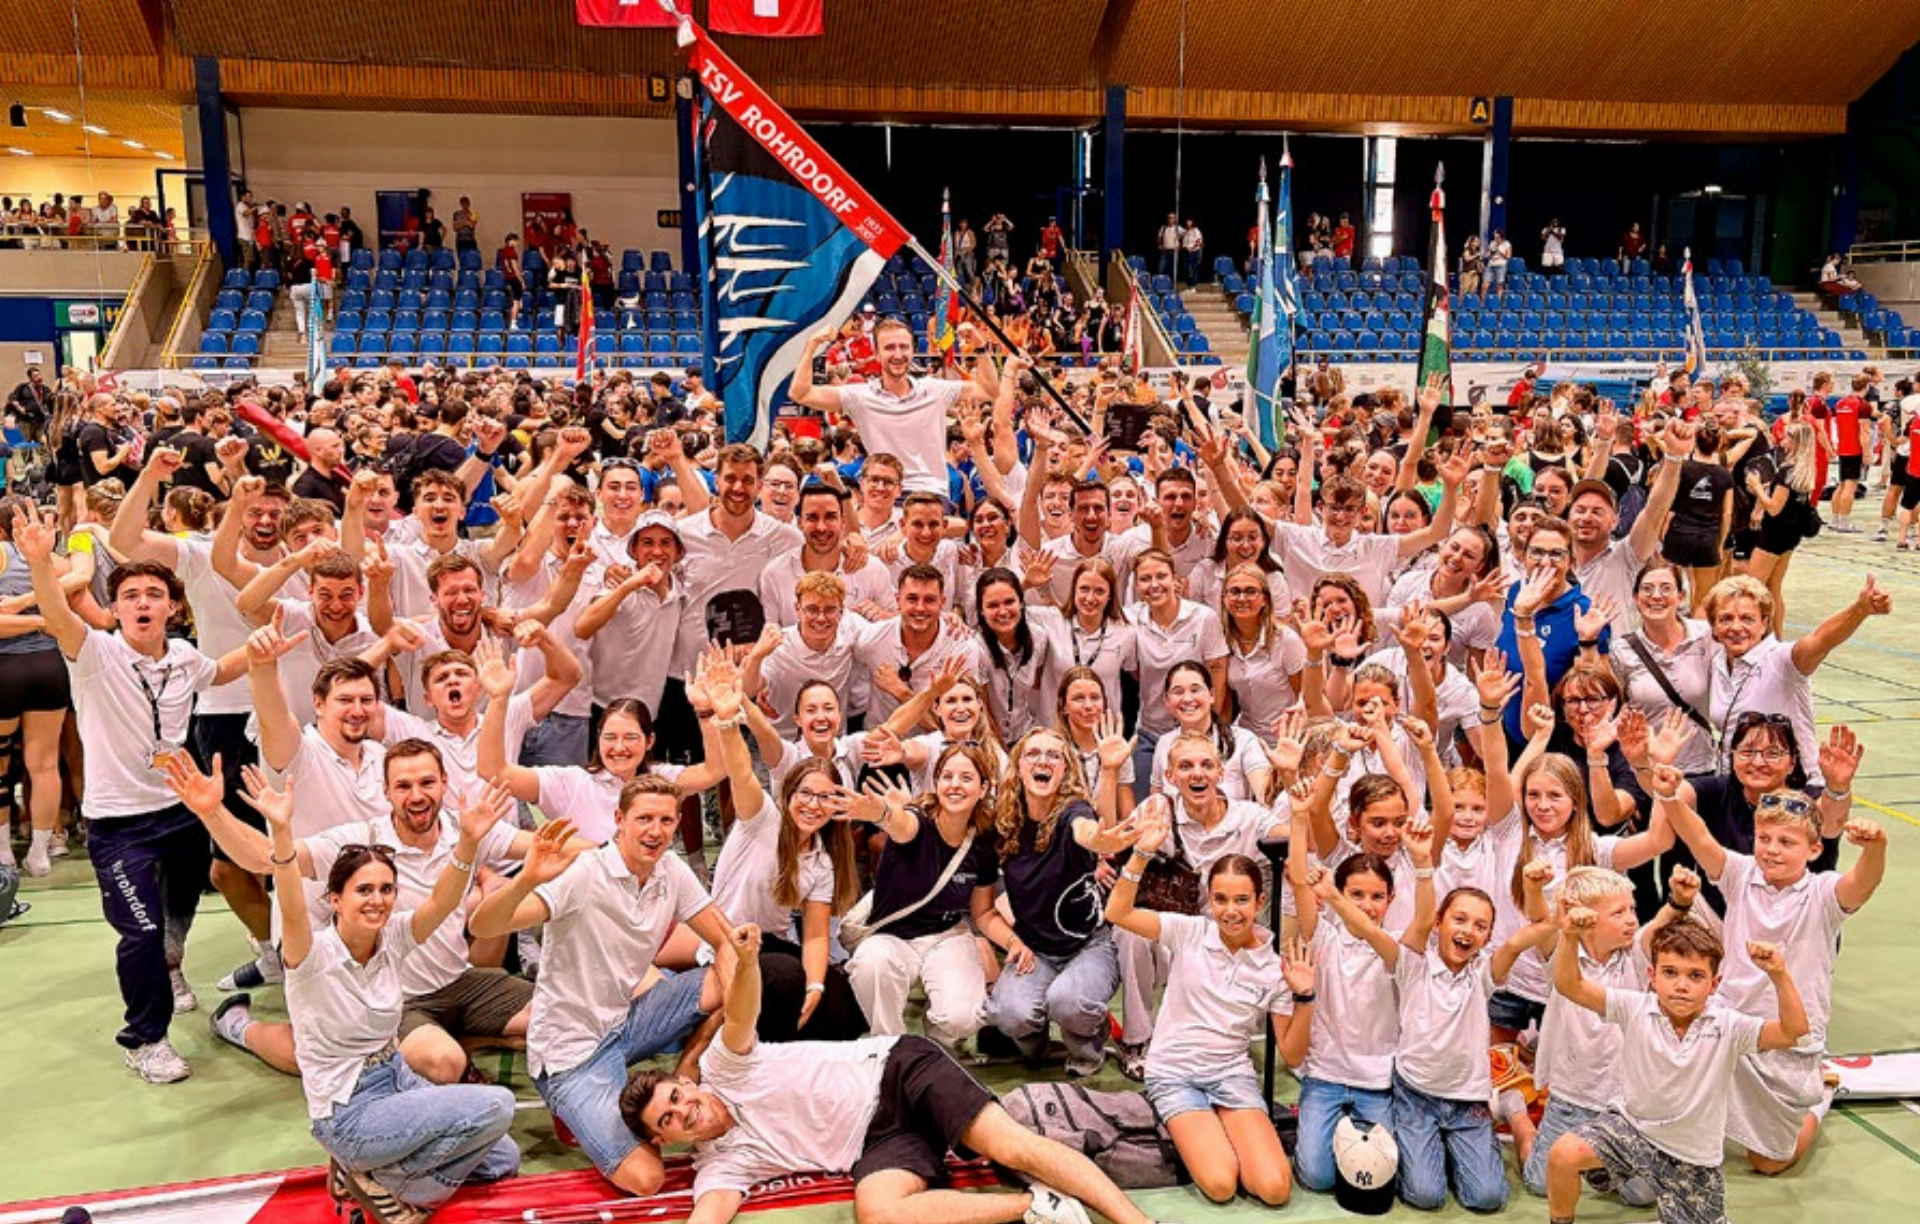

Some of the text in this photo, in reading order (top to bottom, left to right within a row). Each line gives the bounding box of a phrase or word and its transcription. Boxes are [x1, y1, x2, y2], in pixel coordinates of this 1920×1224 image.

[652, 77, 666, 98] B
[1472, 102, 1487, 119] A
[700, 59, 859, 214] TSV ROHRDORF
